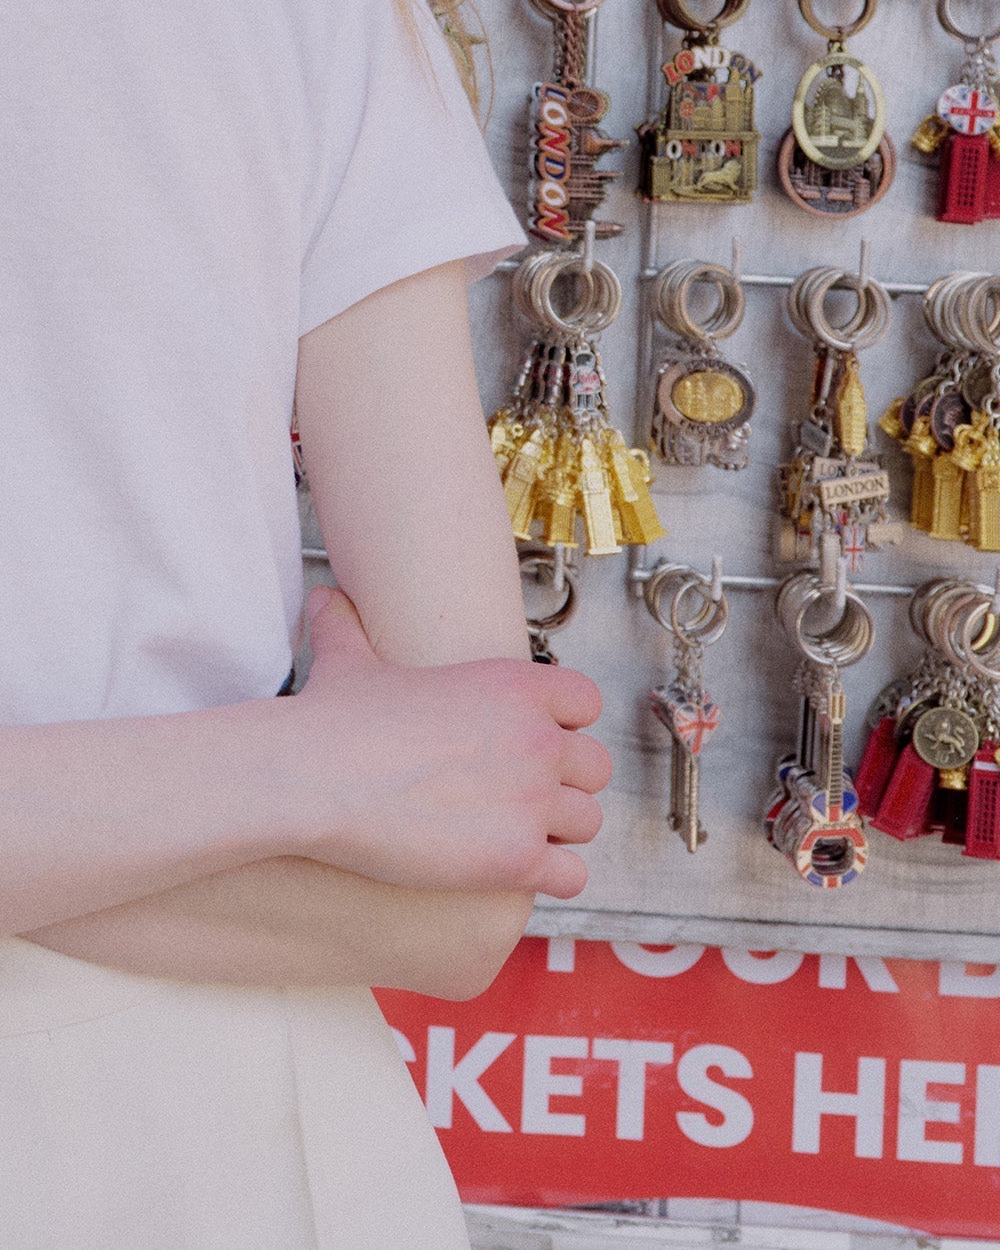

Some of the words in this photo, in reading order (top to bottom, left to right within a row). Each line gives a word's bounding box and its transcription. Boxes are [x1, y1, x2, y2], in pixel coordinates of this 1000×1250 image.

[663, 47, 762, 86] LONDON
[538, 81, 574, 240] LONDON
[825, 476, 885, 500] LONDON
[388, 1024, 755, 1149] KETS
[791, 1051, 1000, 1168] HE
